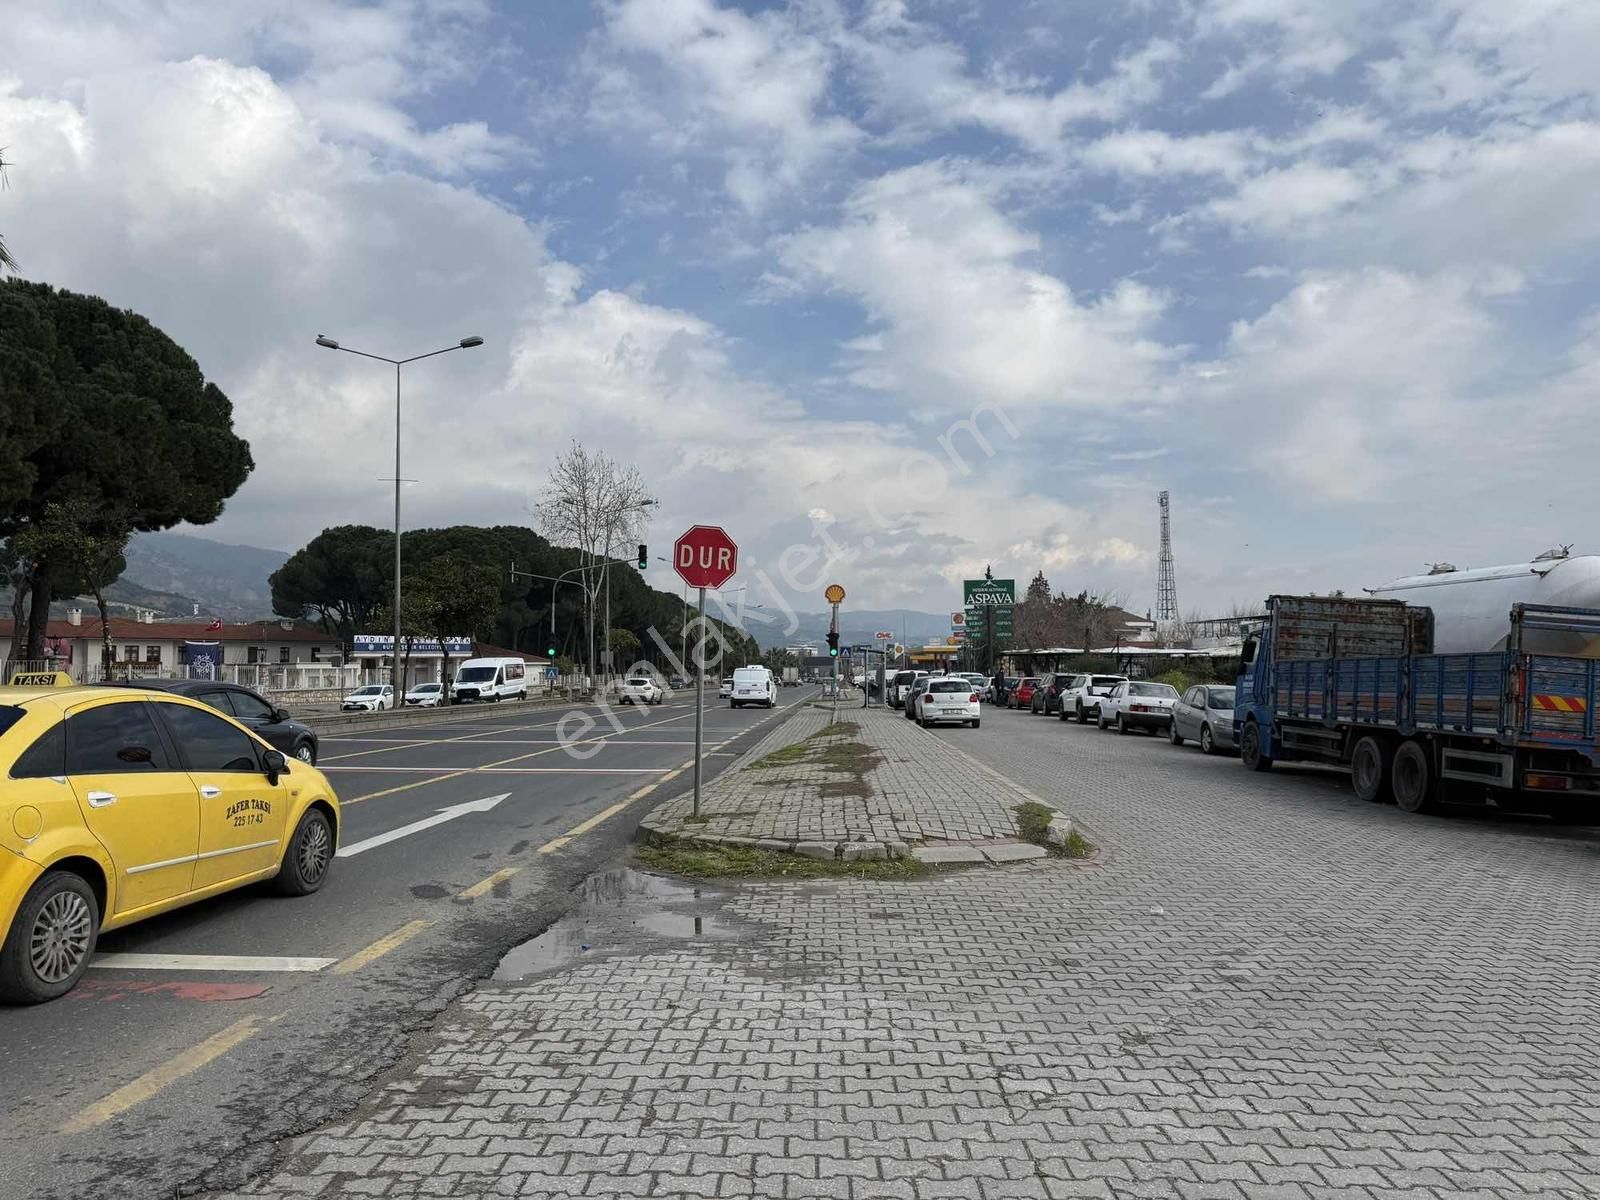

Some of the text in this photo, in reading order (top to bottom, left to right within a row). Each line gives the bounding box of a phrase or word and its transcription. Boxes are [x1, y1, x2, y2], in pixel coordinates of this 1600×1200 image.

[680, 544, 731, 570] DUR
[966, 593, 1013, 604] ASPAVA
[18, 675, 54, 686] TAKSİ
[226, 799, 271, 820] ZAFER TAKSİ
[234, 814, 263, 827] 225 17 43
